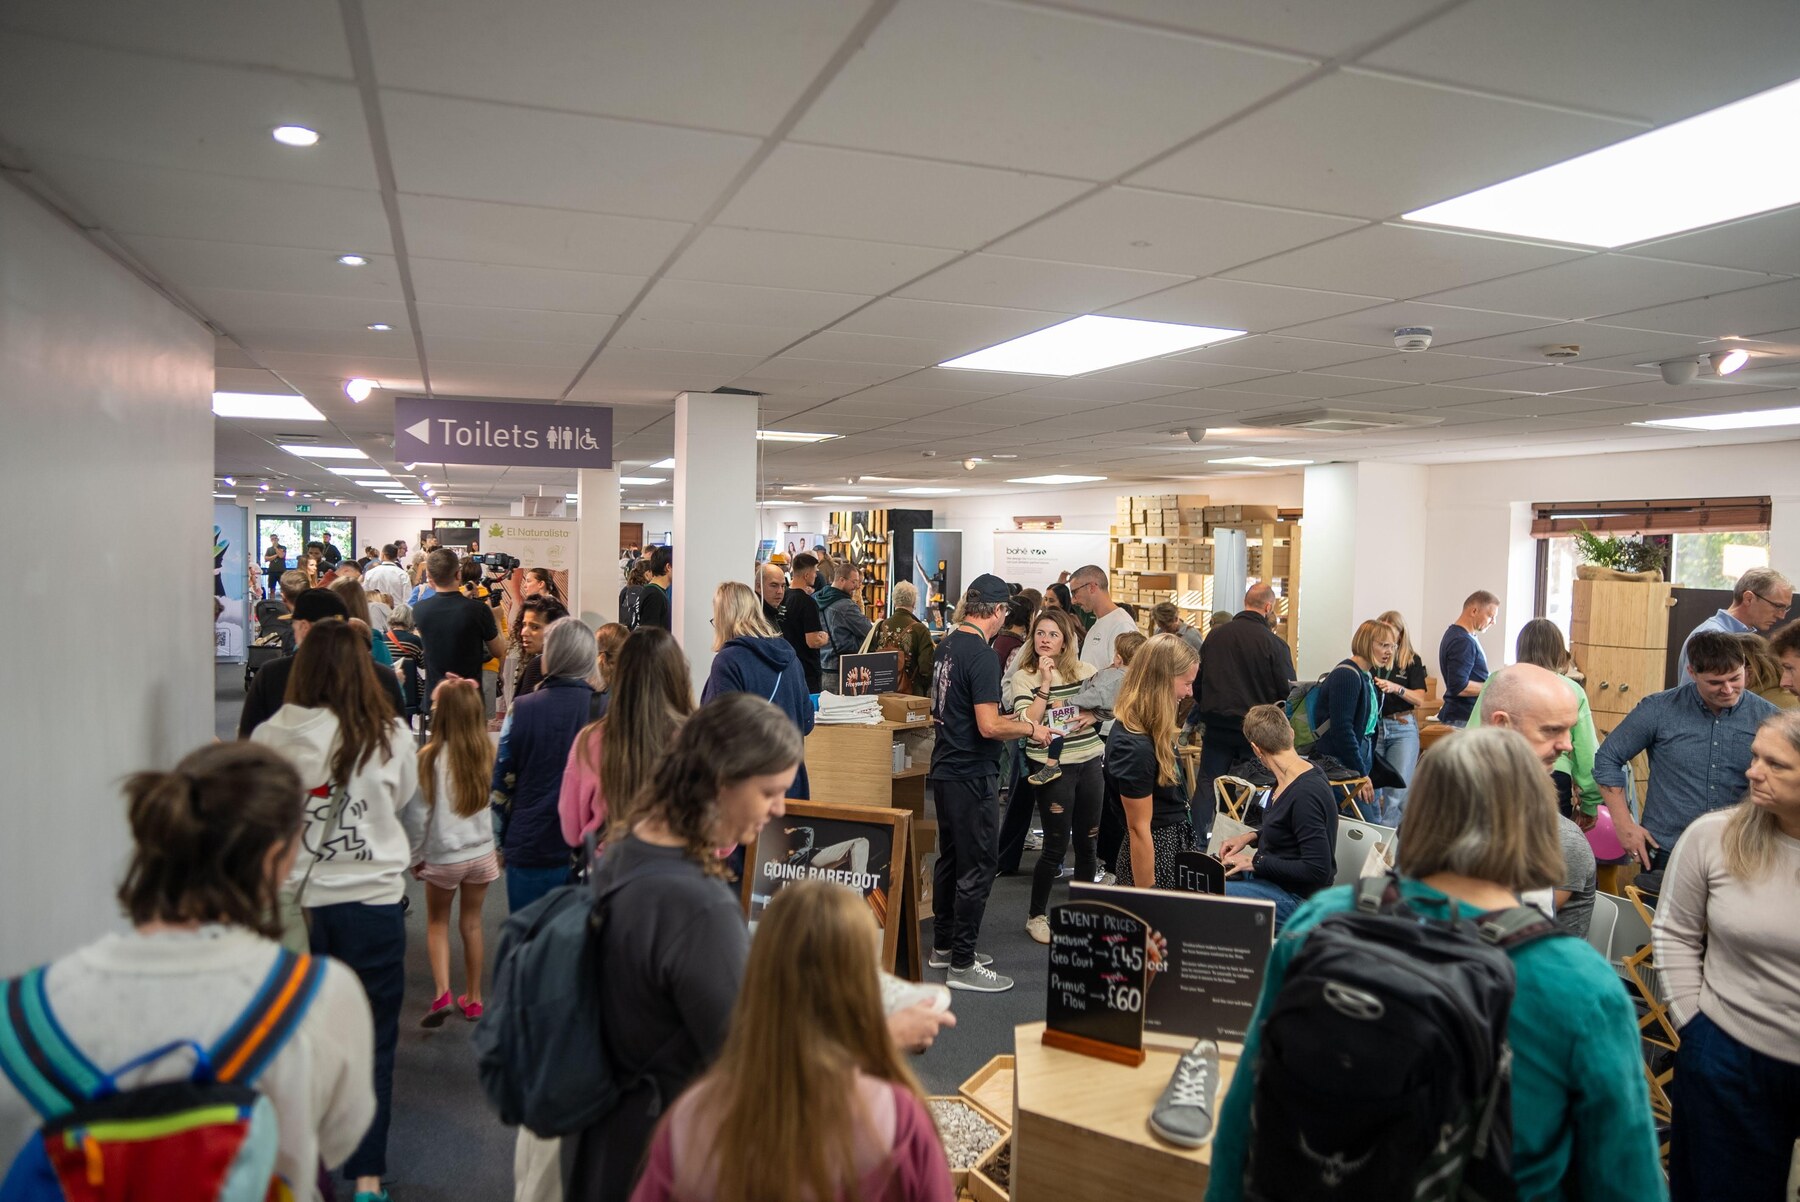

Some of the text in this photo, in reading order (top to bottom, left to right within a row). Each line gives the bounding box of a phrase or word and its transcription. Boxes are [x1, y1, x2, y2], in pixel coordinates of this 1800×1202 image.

[438, 418, 539, 449] Toilets
[507, 528, 569, 538] El Naturalista
[1052, 707, 1075, 718] BARE
[764, 861, 805, 880] GOING
[809, 867, 881, 889] BAREFOOT
[1179, 864, 1216, 896] FEEL
[1060, 909, 1099, 928] EVENT
[1112, 946, 1143, 971] £45
[1051, 973, 1086, 994] Primus
[1062, 992, 1086, 1010] Flow
[1107, 984, 1142, 1013] £60
